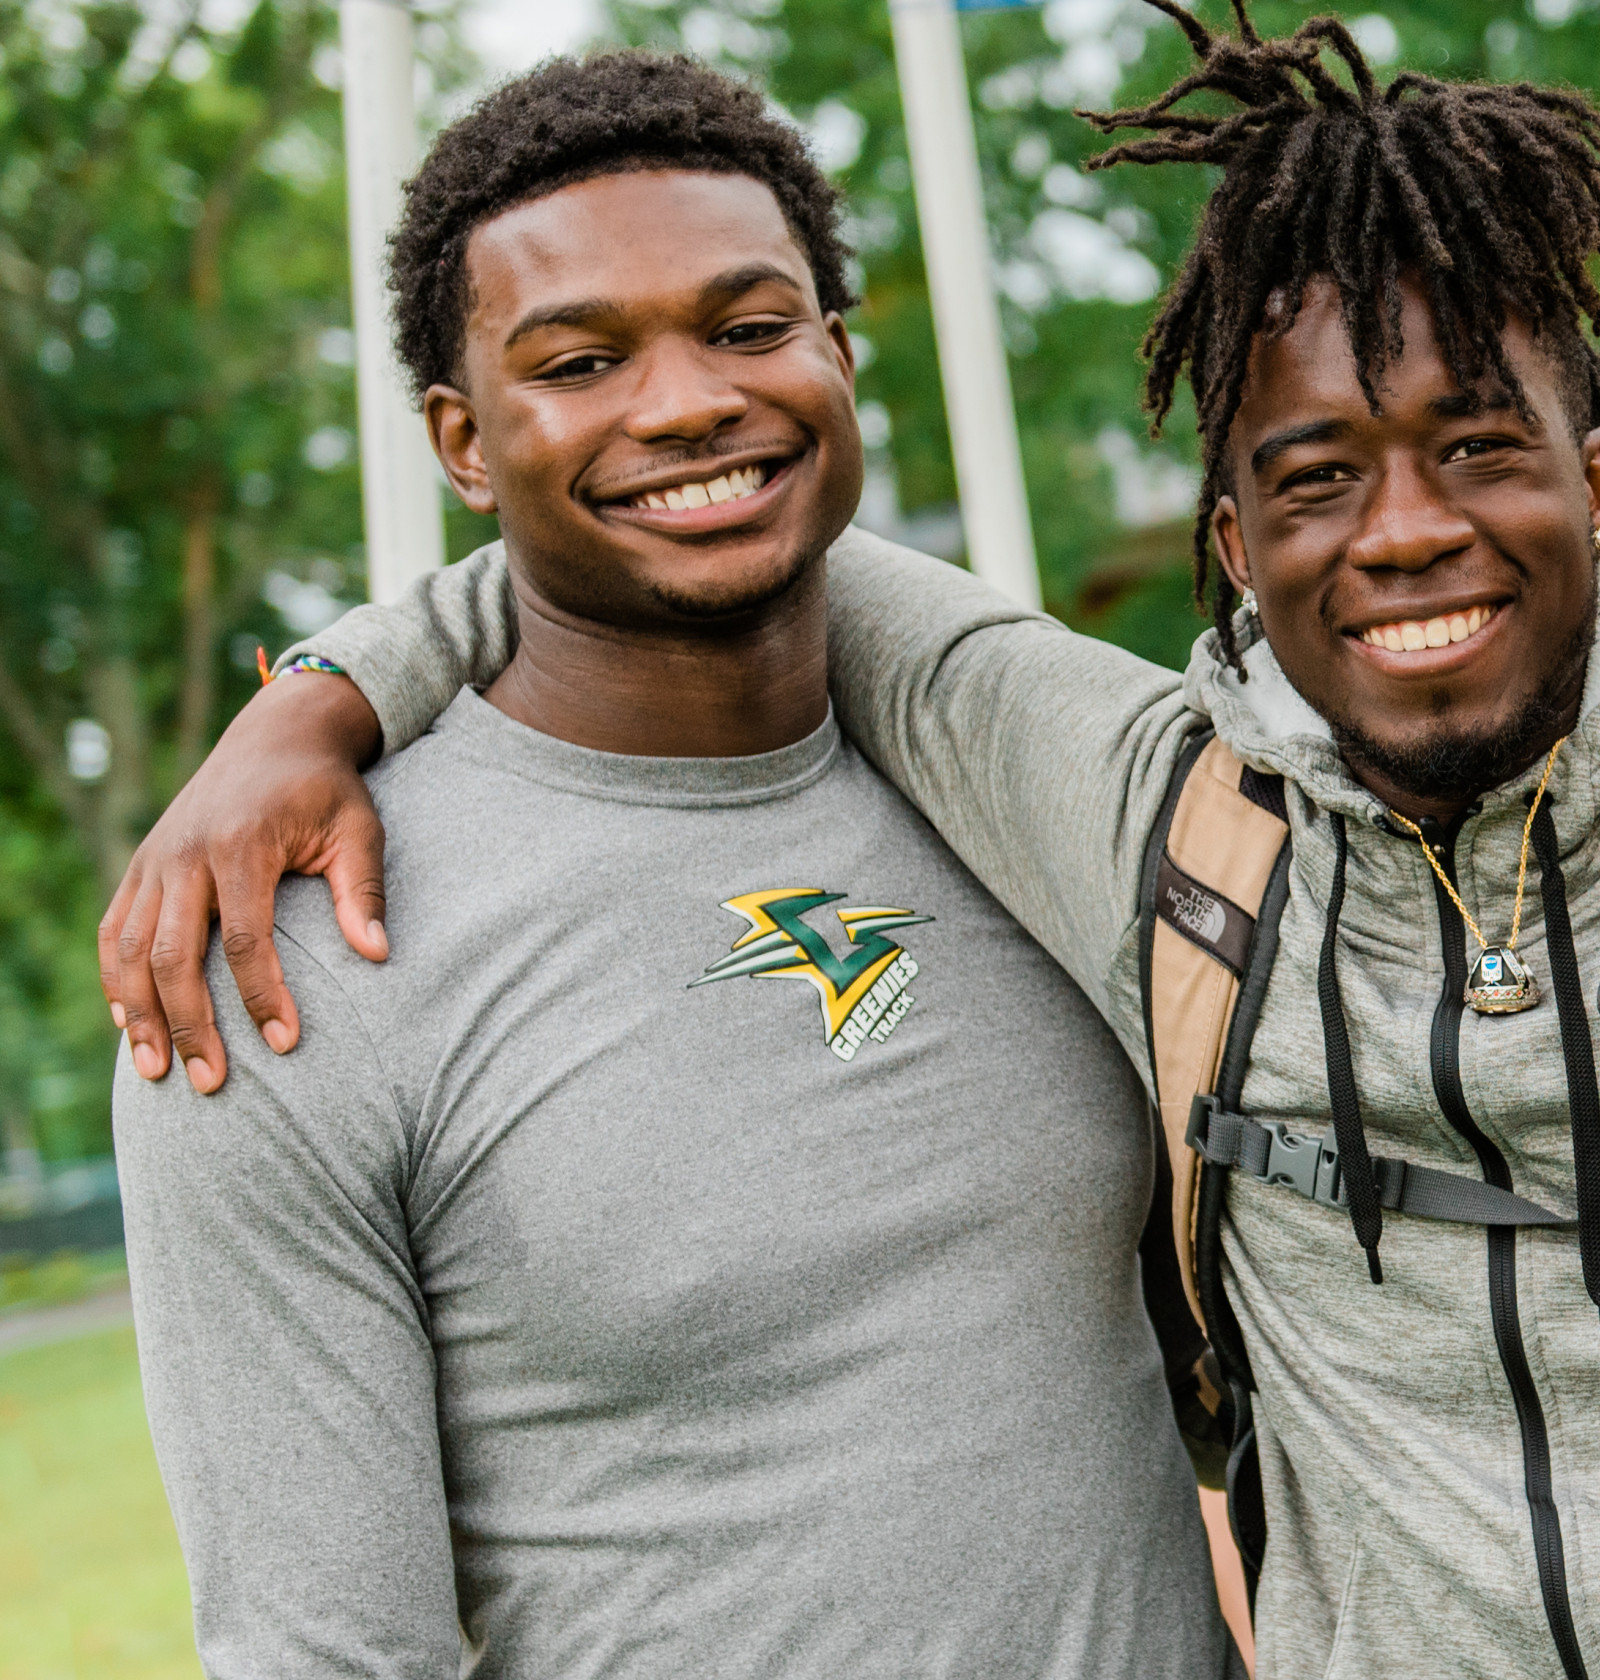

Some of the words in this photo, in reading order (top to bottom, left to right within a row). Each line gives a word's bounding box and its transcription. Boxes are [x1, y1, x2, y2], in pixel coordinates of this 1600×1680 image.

[1166, 886, 1210, 922] NORTH
[1189, 887, 1215, 911] THE
[1173, 905, 1205, 933] FACE
[829, 949, 920, 1063] GREENIES
[868, 990, 917, 1044] TRACK
